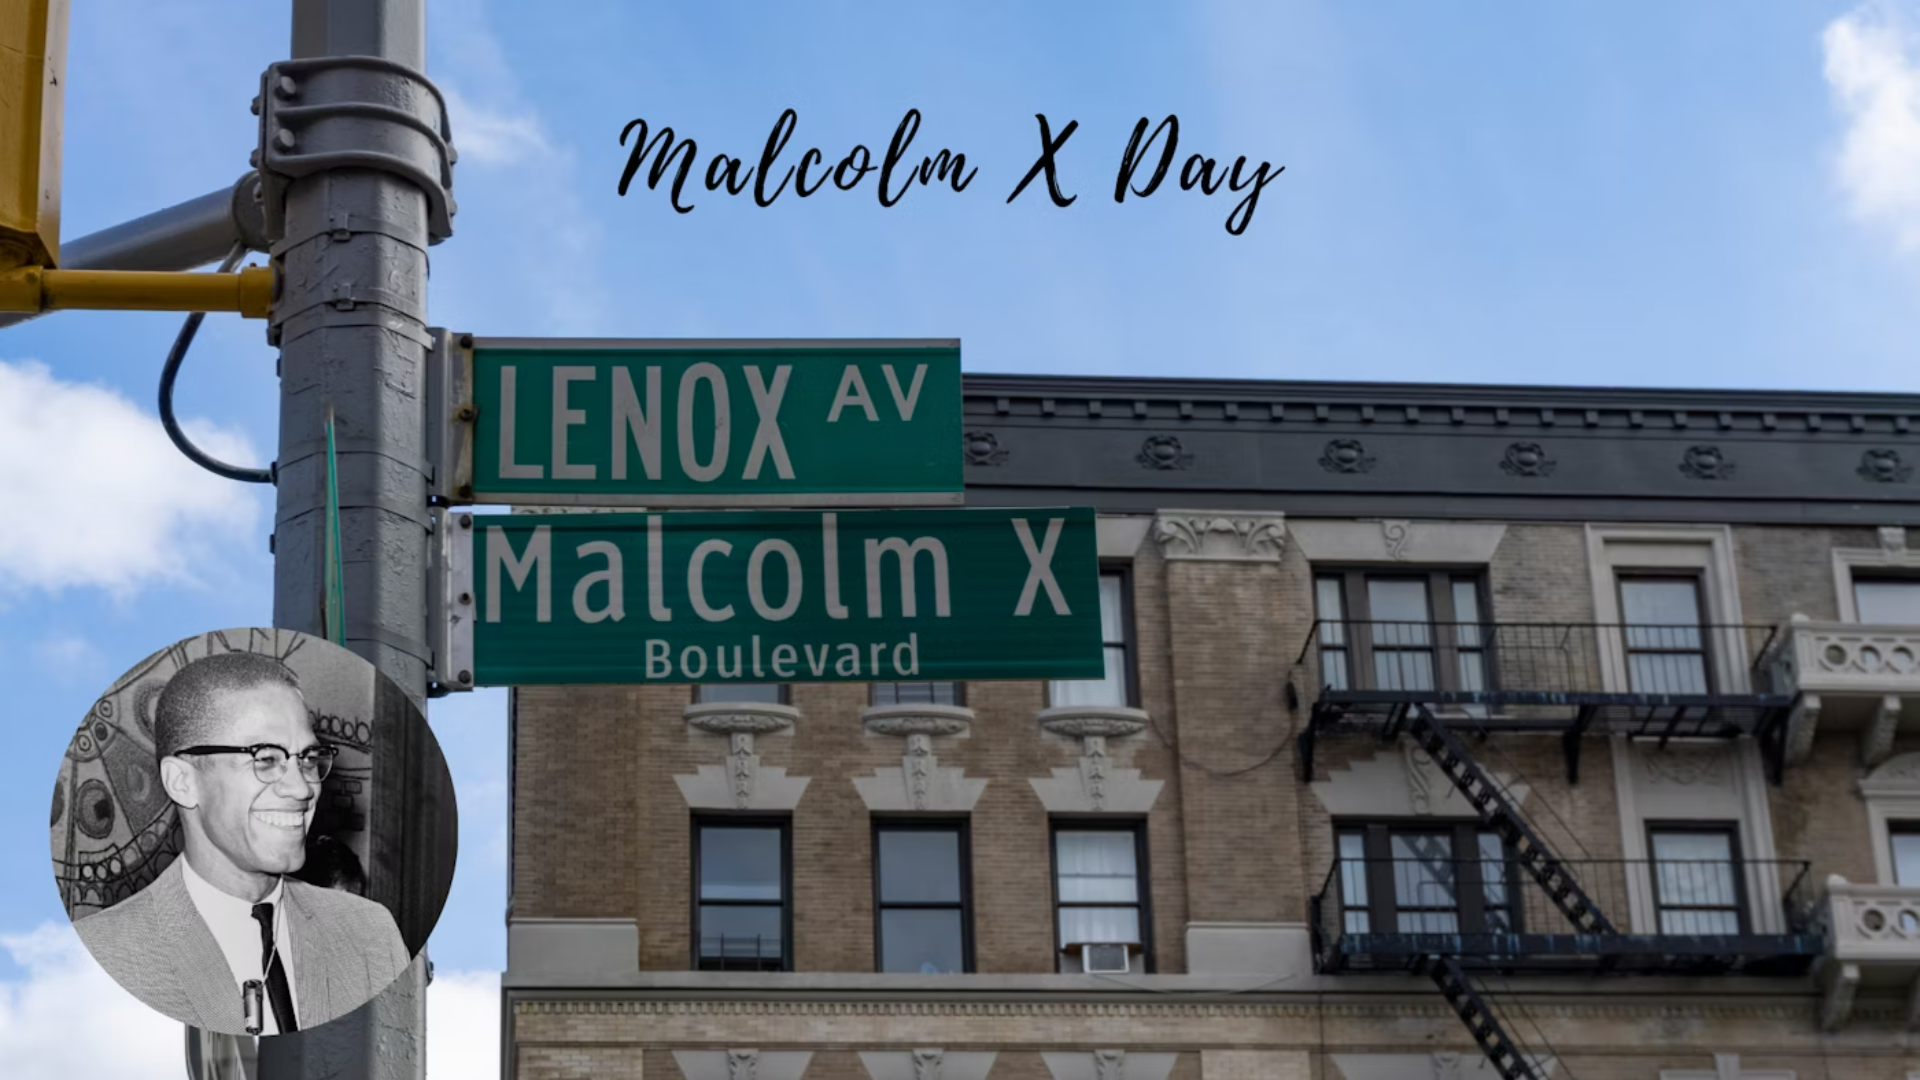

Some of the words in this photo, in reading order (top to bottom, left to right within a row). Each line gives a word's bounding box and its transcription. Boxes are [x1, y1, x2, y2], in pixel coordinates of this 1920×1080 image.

[499, 362, 796, 482] LENOX
[827, 364, 928, 422] AV
[485, 512, 951, 623] Malcolm
[1010, 517, 1072, 616] X
[645, 632, 920, 679] Boulevard
